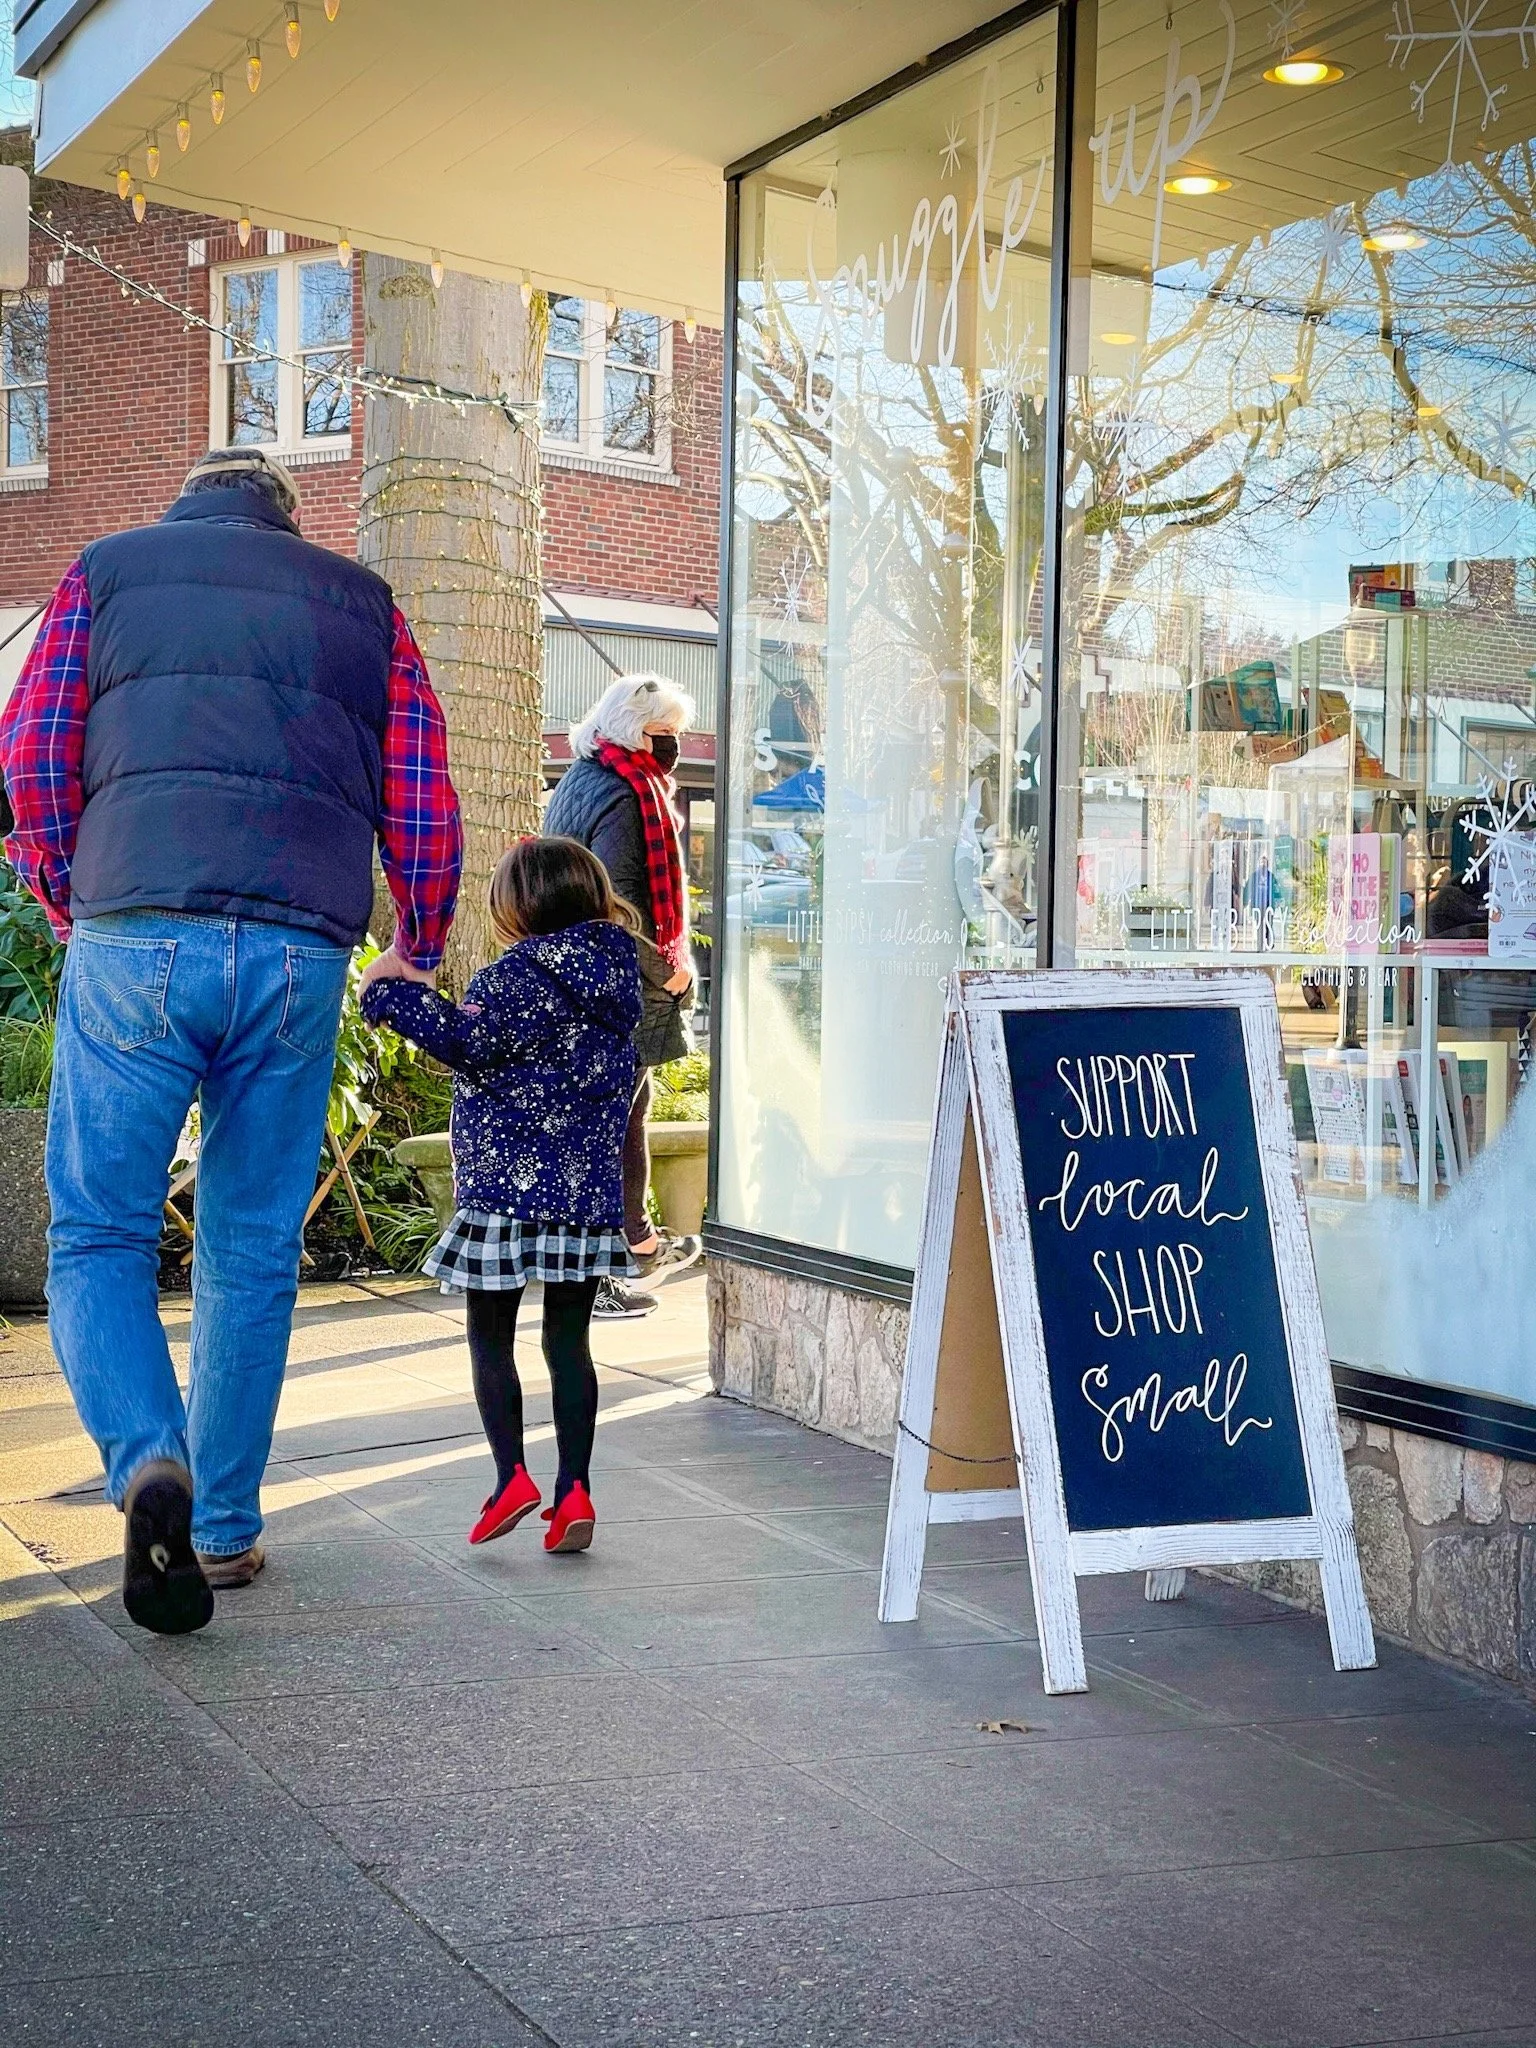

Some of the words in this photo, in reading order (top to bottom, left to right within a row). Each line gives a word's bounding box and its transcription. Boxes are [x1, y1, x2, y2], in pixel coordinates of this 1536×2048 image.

[1088, 0, 1237, 270] up
[786, 909, 832, 945] LITTLE
[880, 908, 954, 946] collection
[1150, 908, 1219, 951] LITTLE
[1230, 906, 1289, 952] BIPSY
[1299, 901, 1423, 948] collection
[1359, 967, 1366, 987] &
[1370, 967, 1398, 988] EAR
[1056, 1052, 1198, 1139] SUPPORT
[1038, 1146, 1249, 1232] local
[1093, 1243, 1204, 1337] SHOP
[1081, 1352, 1273, 1462] Small
